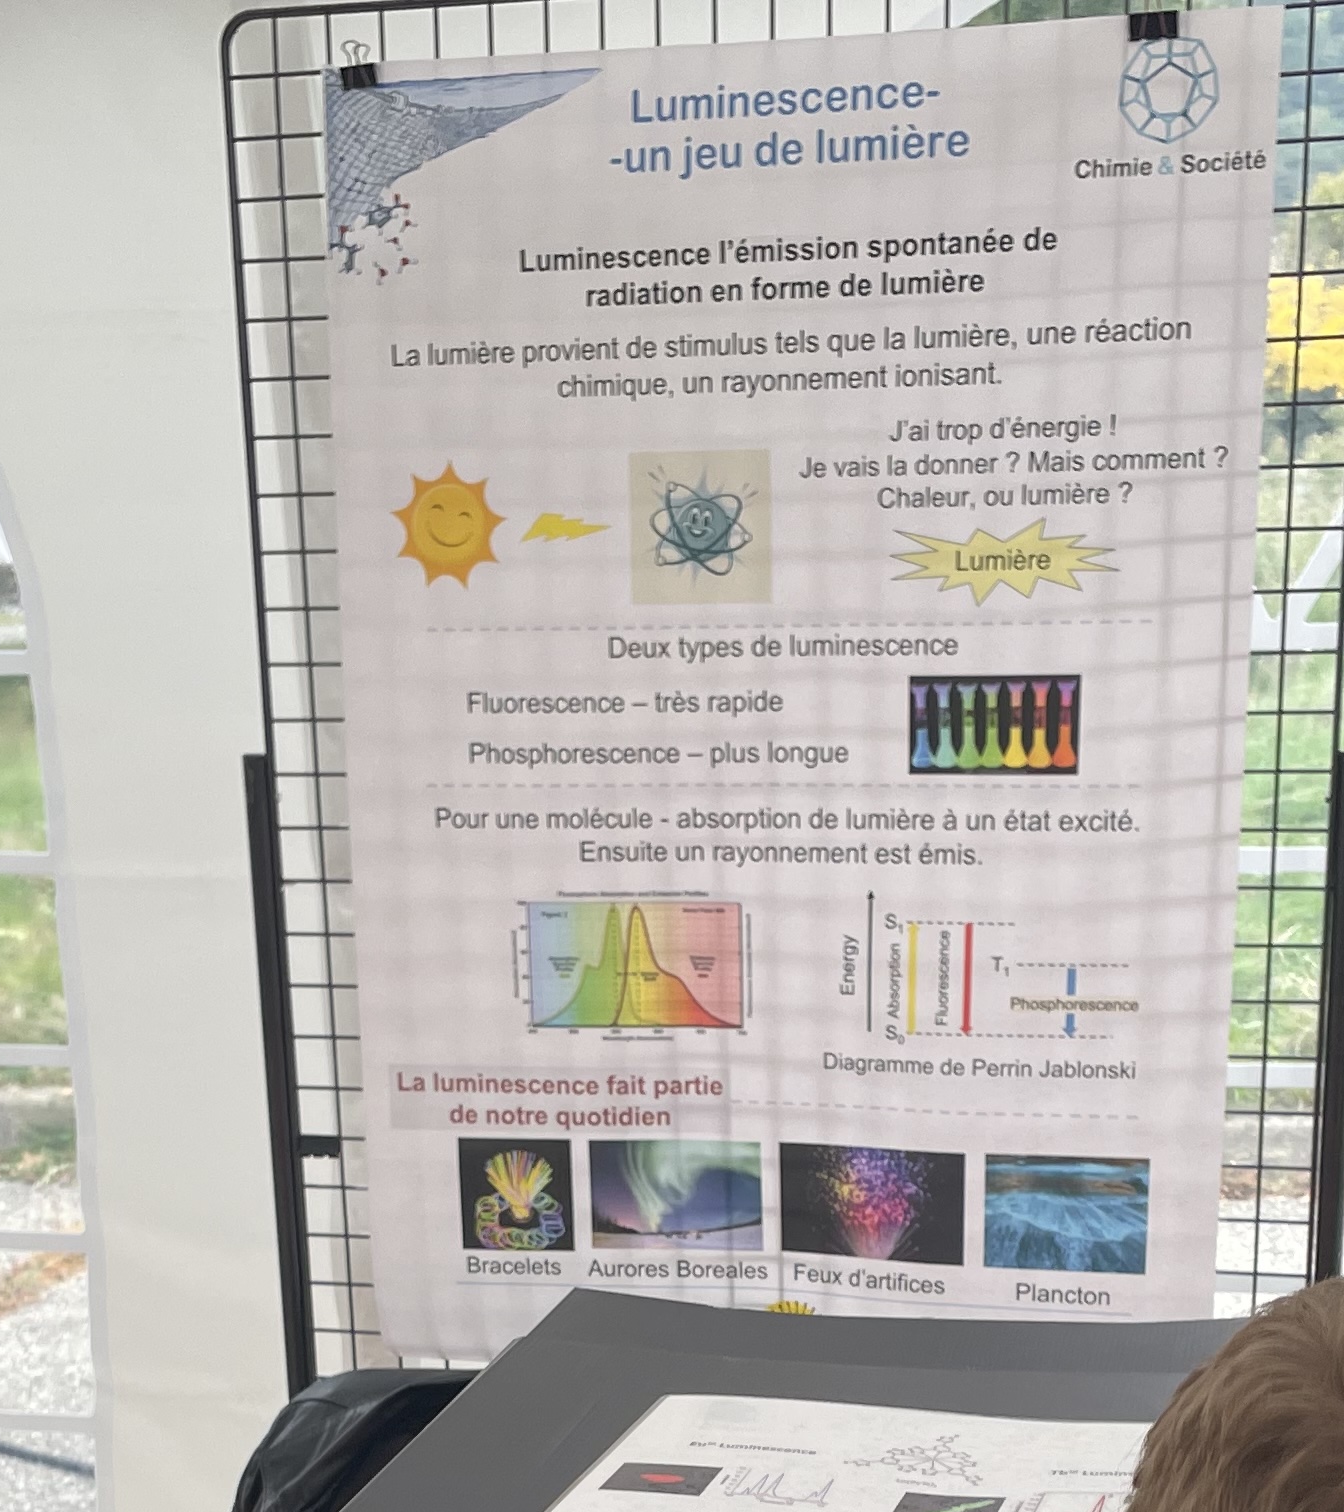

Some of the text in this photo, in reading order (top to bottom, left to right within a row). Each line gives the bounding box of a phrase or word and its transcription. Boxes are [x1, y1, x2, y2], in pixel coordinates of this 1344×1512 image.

[631, 83, 940, 122] Luminescence-
[678, 136, 742, 179] jeu
[754, 131, 804, 166] de
[816, 125, 970, 163] lumière
[1074, 149, 1266, 179] Chimie Société
[519, 226, 1057, 272] Luminescence l'émission spontanée de
[586, 268, 985, 306] radiation en forme de lumière
[889, 415, 1102, 445] J'ai trop d'énergie
[798, 448, 1206, 479] Je vais la donner Mais comment
[876, 482, 1110, 509] Chaleur, ou lumière
[954, 547, 1052, 575] Lumière
[607, 634, 958, 664] Deux types de luminescence
[465, 689, 783, 717] Fluorescence très rapide
[468, 741, 849, 769] Phosphorescence plus longue
[840, 934, 860, 996] Energy
[935, 930, 951, 1026] Fluorescence
[887, 943, 903, 1019] Absorption
[1010, 996, 1140, 1015] Phosphorescence
[823, 1052, 1136, 1079] Diagramme de Perrin Jablonski
[397, 1071, 723, 1099] La luminescence fait partie
[449, 1103, 670, 1131] de notre quotidien
[466, 1255, 562, 1276] Bracelets
[587, 1259, 770, 1281] Aurores Boreales
[793, 1263, 945, 1294] Feux d'artifices
[1015, 1282, 1110, 1305] Plancton
